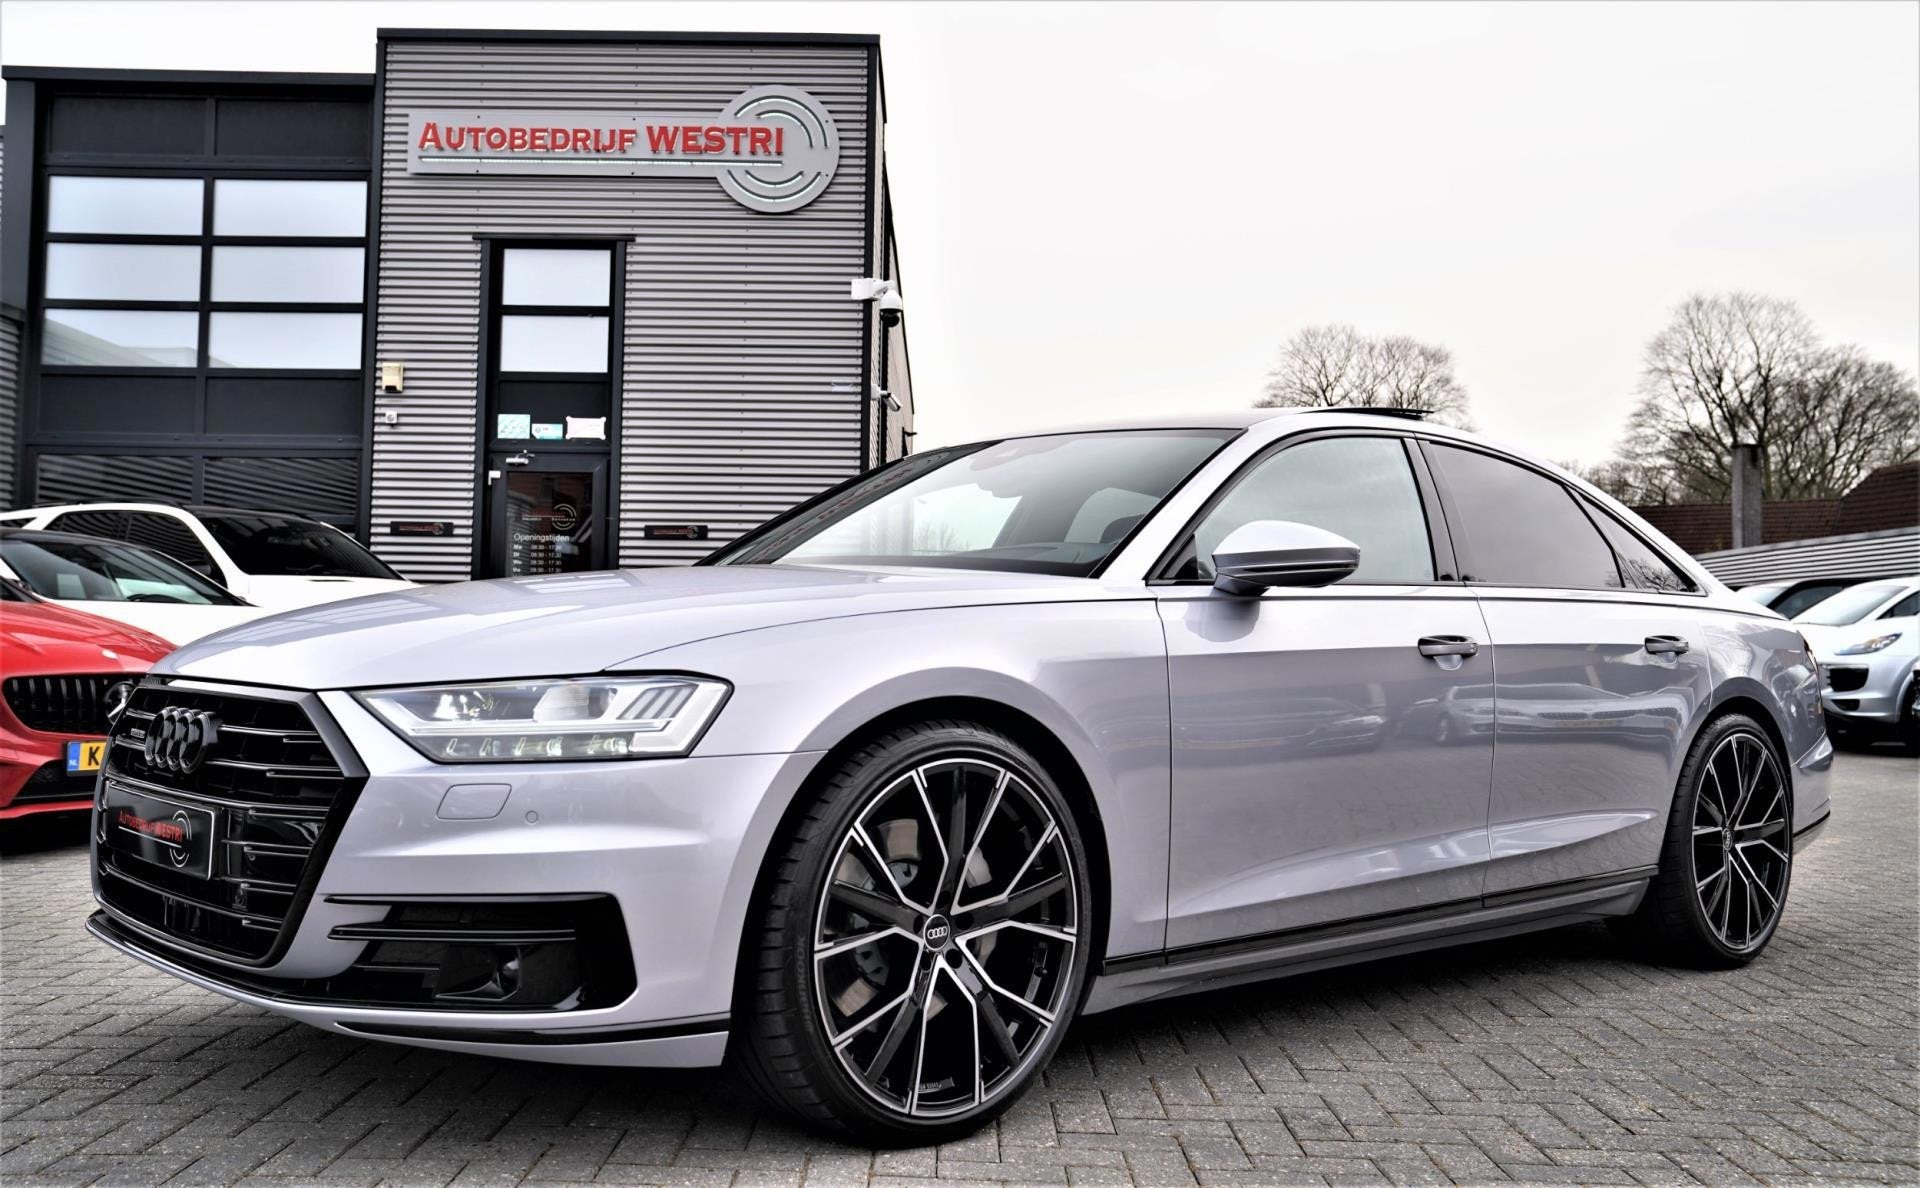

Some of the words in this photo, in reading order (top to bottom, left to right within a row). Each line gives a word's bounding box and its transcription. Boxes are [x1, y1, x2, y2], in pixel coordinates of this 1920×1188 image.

[418, 122, 637, 153] AUTOBEDRIJF
[646, 125, 784, 155] WESTRI
[513, 533, 570, 542] Openingstijden
[155, 822, 183, 843] WESTRI
